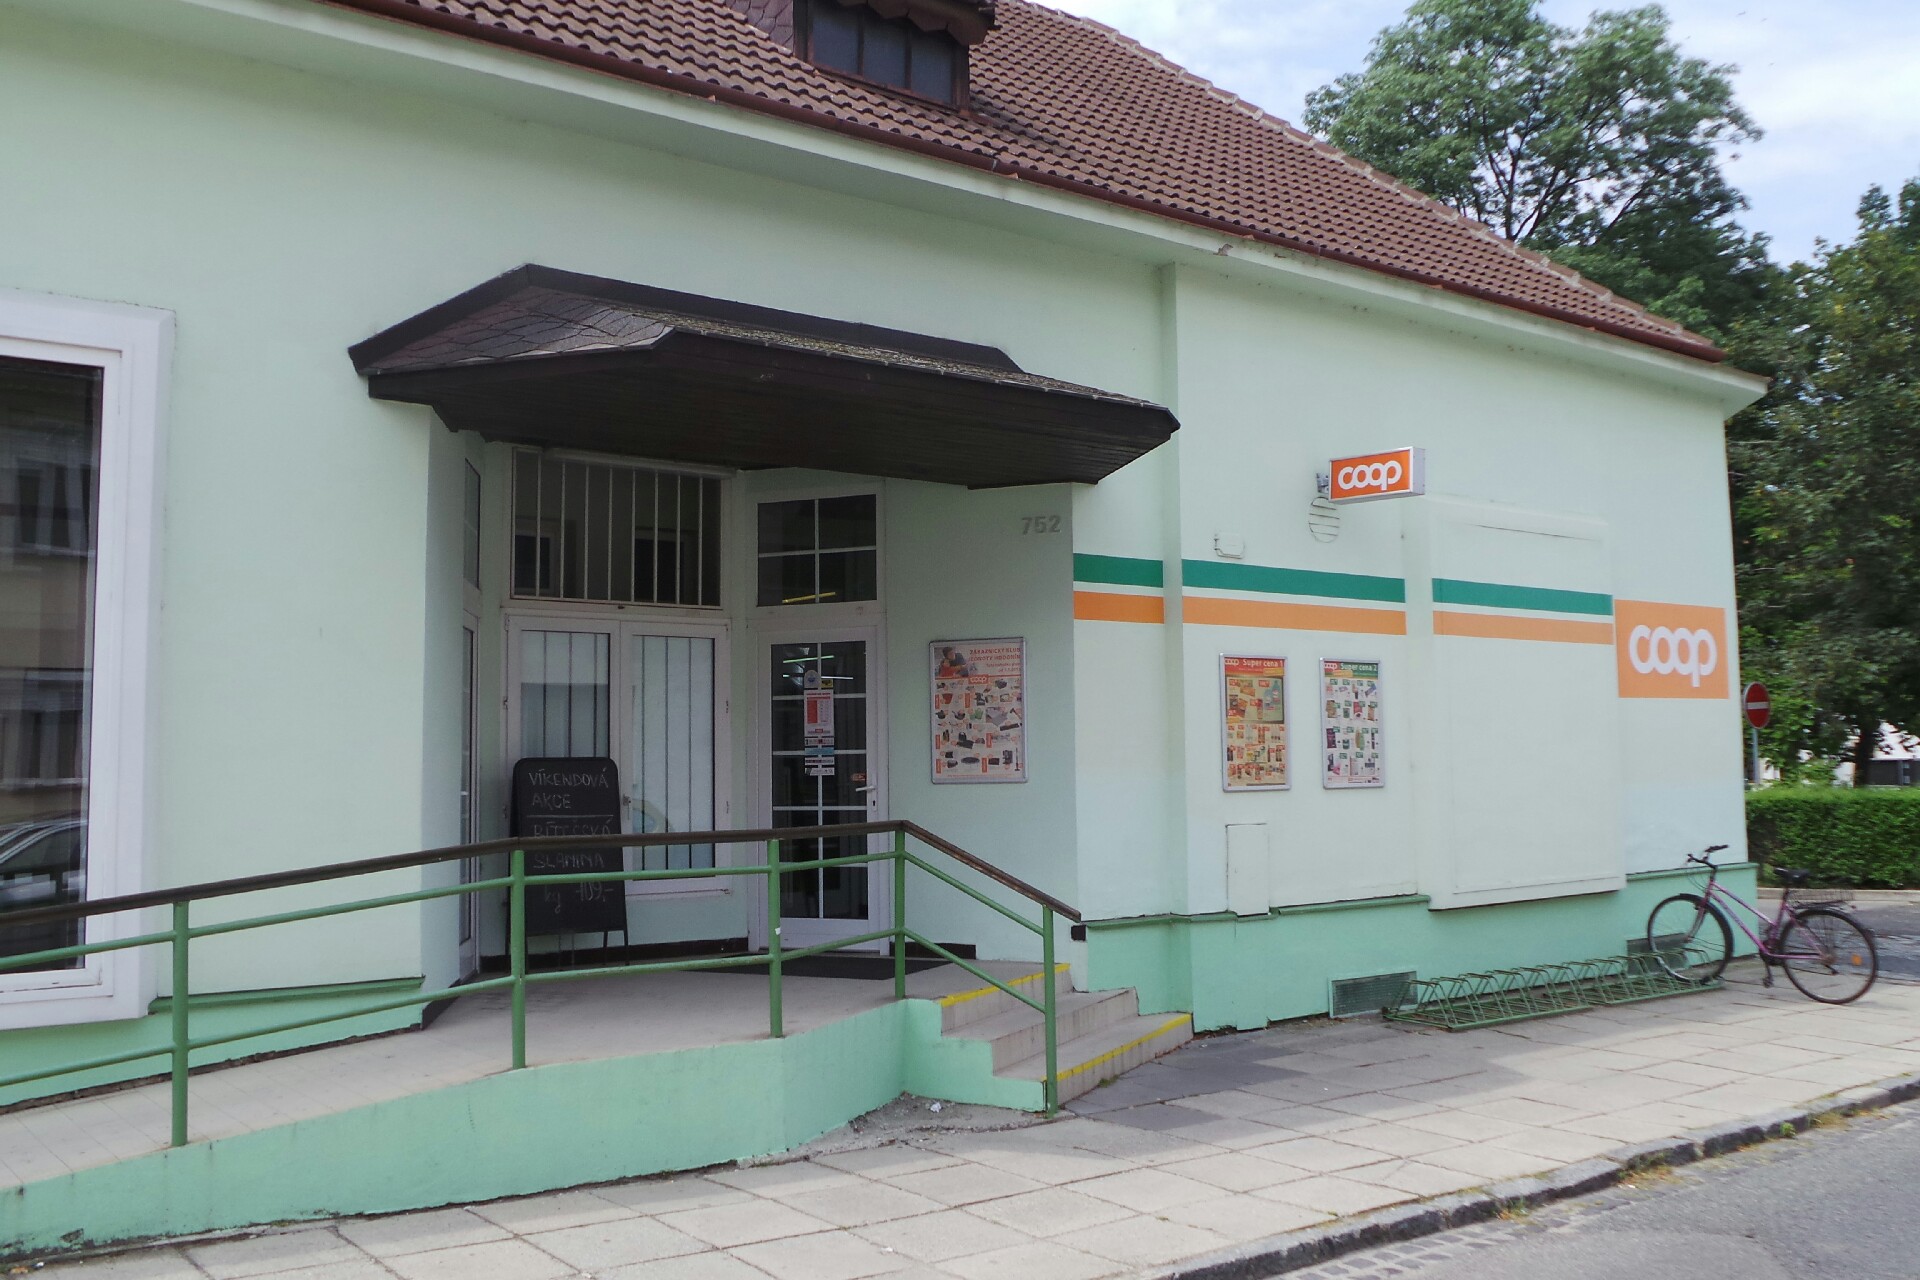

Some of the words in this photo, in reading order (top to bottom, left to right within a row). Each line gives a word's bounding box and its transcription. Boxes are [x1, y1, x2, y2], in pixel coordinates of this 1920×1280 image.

[1338, 460, 1402, 491] coop
[1022, 515, 1061, 535] 752
[1242, 659, 1262, 668] Super
[1629, 624, 1717, 687] coop
[1340, 663, 1358, 672] Super
[970, 676, 987, 684] coop
[528, 767, 609, 789] VÍKENDOVÁ
[532, 793, 572, 811] AKCE
